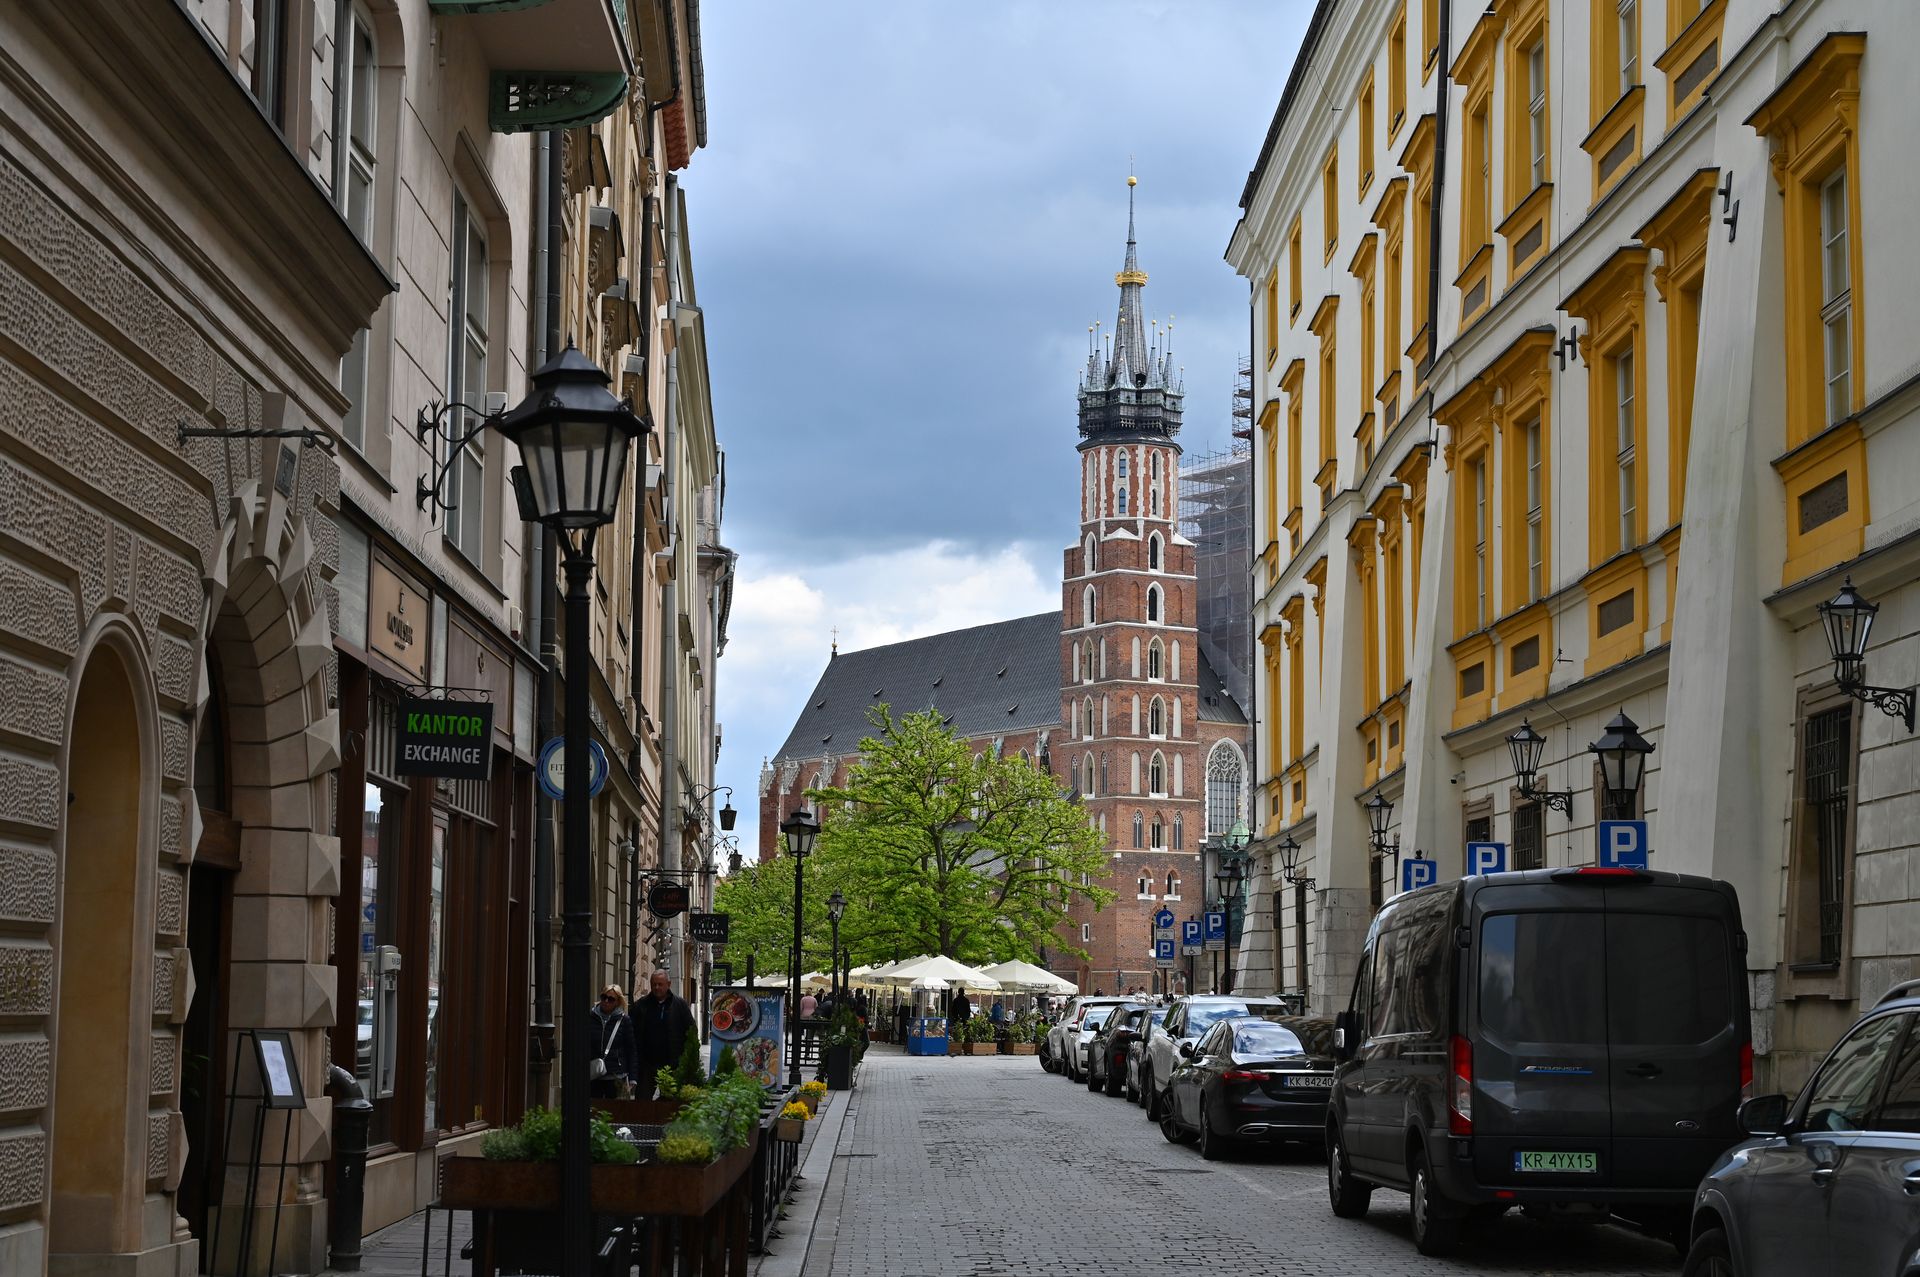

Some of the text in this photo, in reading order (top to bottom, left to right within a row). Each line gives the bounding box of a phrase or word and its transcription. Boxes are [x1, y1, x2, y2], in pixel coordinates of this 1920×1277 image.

[407, 713, 483, 737] KANTOR
[404, 744, 481, 764] EXCHANGE
[1610, 825, 1637, 862] P
[1475, 846, 1498, 875] P
[1411, 863, 1430, 888] P
[1186, 923, 1198, 939] P
[1209, 914, 1222, 932] P
[1160, 942, 1171, 957] P
[1289, 1077, 1302, 1087] KK
[1523, 1153, 1593, 1169] KR 4YX15
